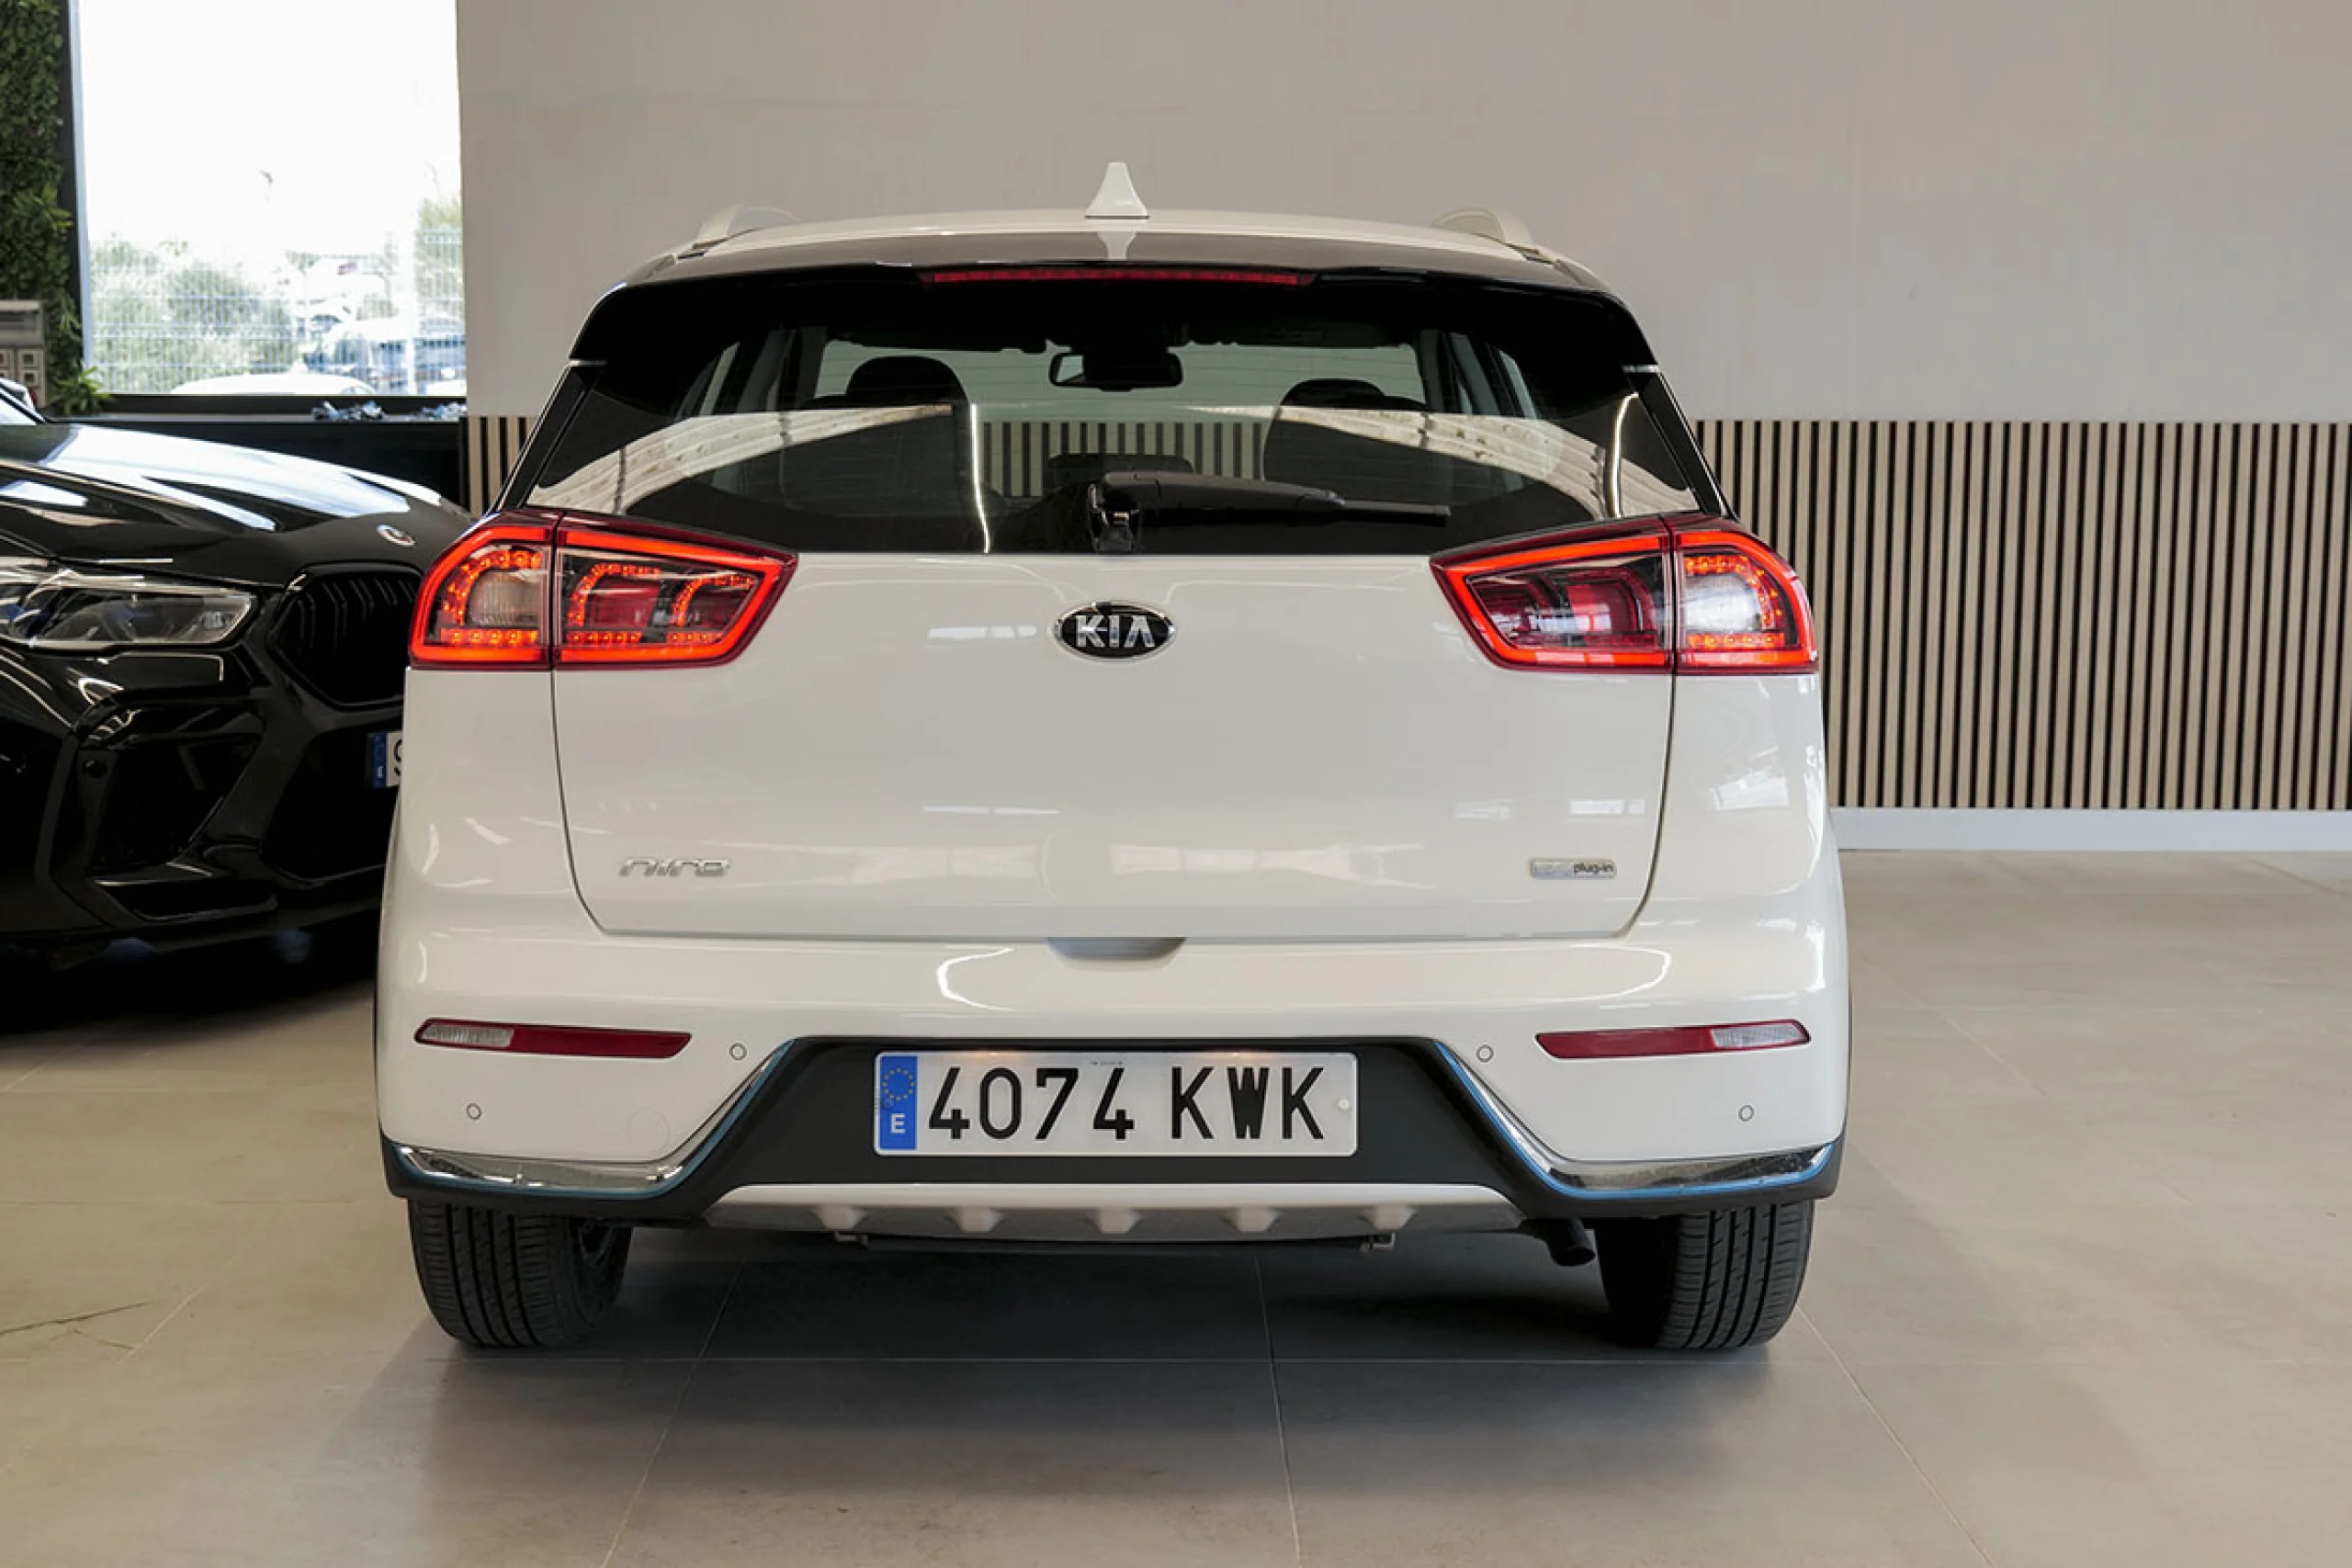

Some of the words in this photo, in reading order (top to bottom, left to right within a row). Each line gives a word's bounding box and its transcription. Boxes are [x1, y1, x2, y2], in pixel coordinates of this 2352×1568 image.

[1075, 615, 1156, 648] KIA
[618, 856, 732, 877] niro
[1573, 862, 1614, 875] plug-in
[928, 1067, 1135, 1140] 4074
[1171, 1066, 1324, 1140] KWK
[890, 1112, 906, 1134] E
